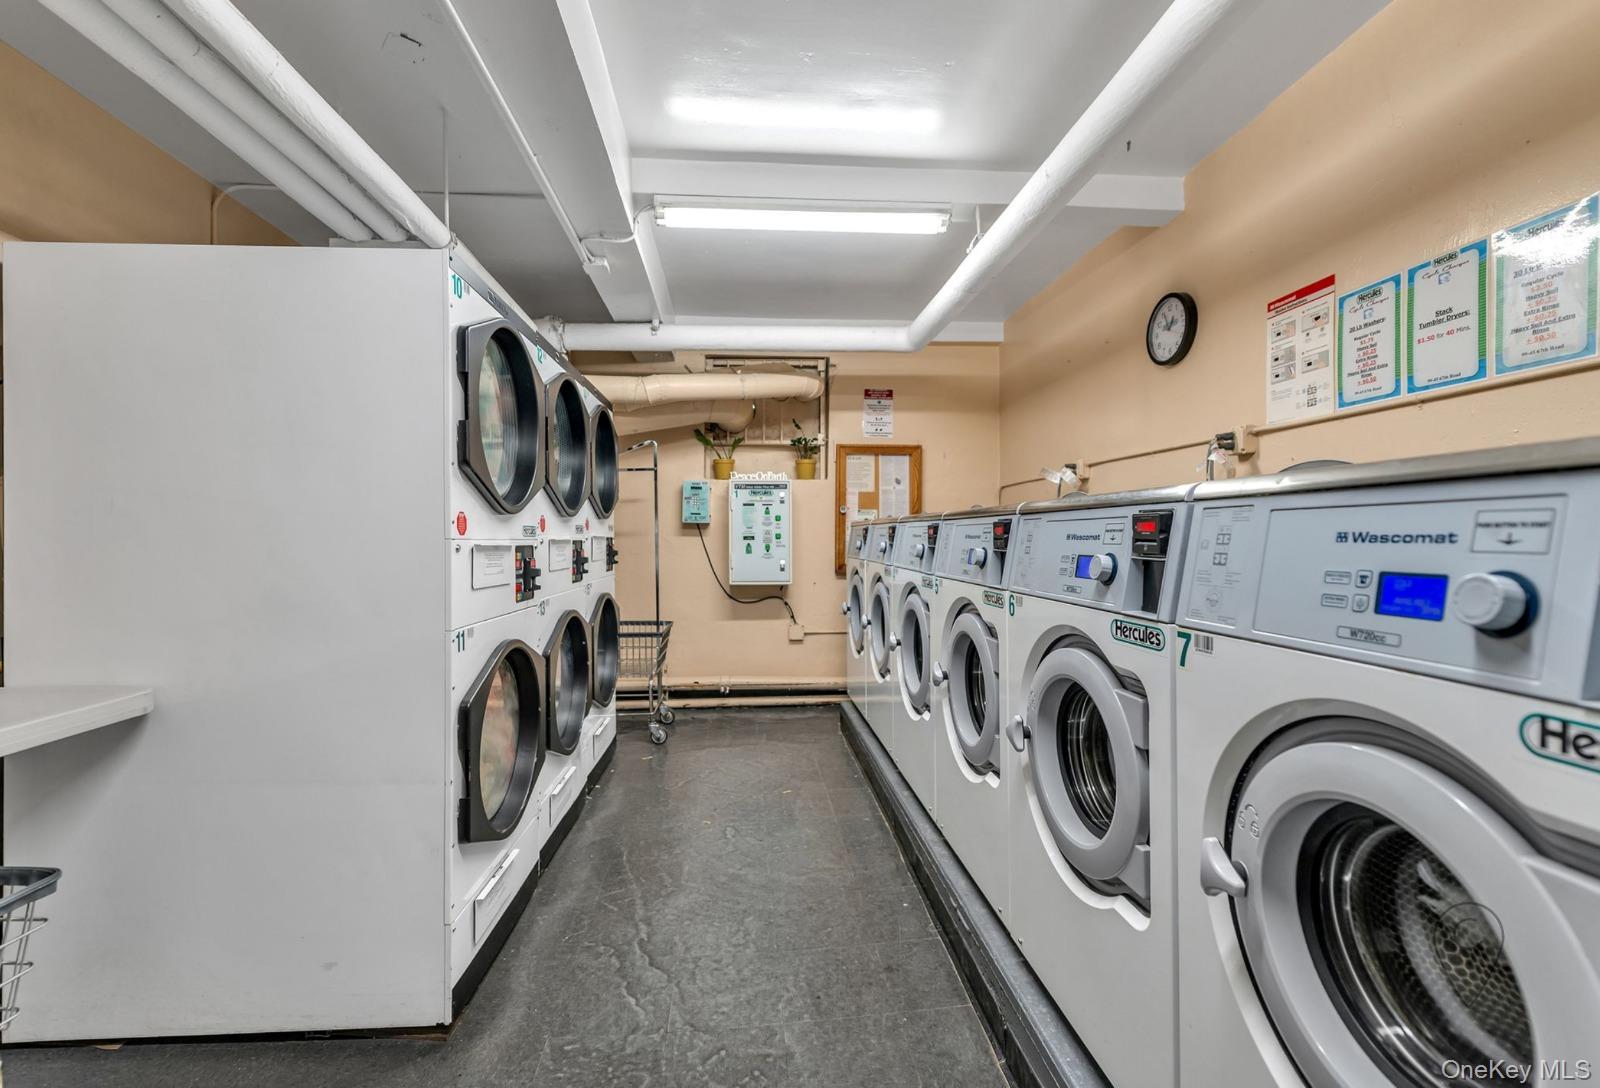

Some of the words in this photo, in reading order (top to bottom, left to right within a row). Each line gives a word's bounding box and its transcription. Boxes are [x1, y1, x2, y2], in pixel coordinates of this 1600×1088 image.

[1527, 217, 1565, 236] Hercul
[1434, 252, 1458, 266] Hercules
[452, 274, 462, 299] 10
[1521, 278, 1545, 287] Regular
[1546, 271, 1564, 280] Cycle
[1358, 288, 1382, 301] Hercules
[1525, 292, 1544, 302] Heavy
[1546, 286, 1559, 294] Soil
[1435, 307, 1453, 317] Stack
[1524, 309, 1540, 317] Extra
[1542, 303, 1560, 311] Rinse
[1418, 317, 1445, 330] Tumbler
[1446, 310, 1470, 322] Dryers:
[1510, 325, 1529, 336] Heavy
[1531, 321, 1543, 329] Soil
[1544, 318, 1557, 326] And
[1558, 313, 1576, 322] Extra
[1417, 335, 1435, 345] $1.50
[1437, 331, 1445, 339] for
[1446, 329, 1455, 337] 40
[1532, 327, 1550, 335] Rinse
[1071, 533, 1101, 541] Wascomat
[1352, 530, 1459, 544] Wascomat
[934, 578, 939, 594] 5
[984, 591, 1004, 606] Hercules
[1009, 594, 1015, 617] 6
[1115, 619, 1161, 646] Hercules
[1350, 628, 1387, 644] W720cc
[456, 630, 465, 653] 11
[1177, 631, 1192, 667] 7
